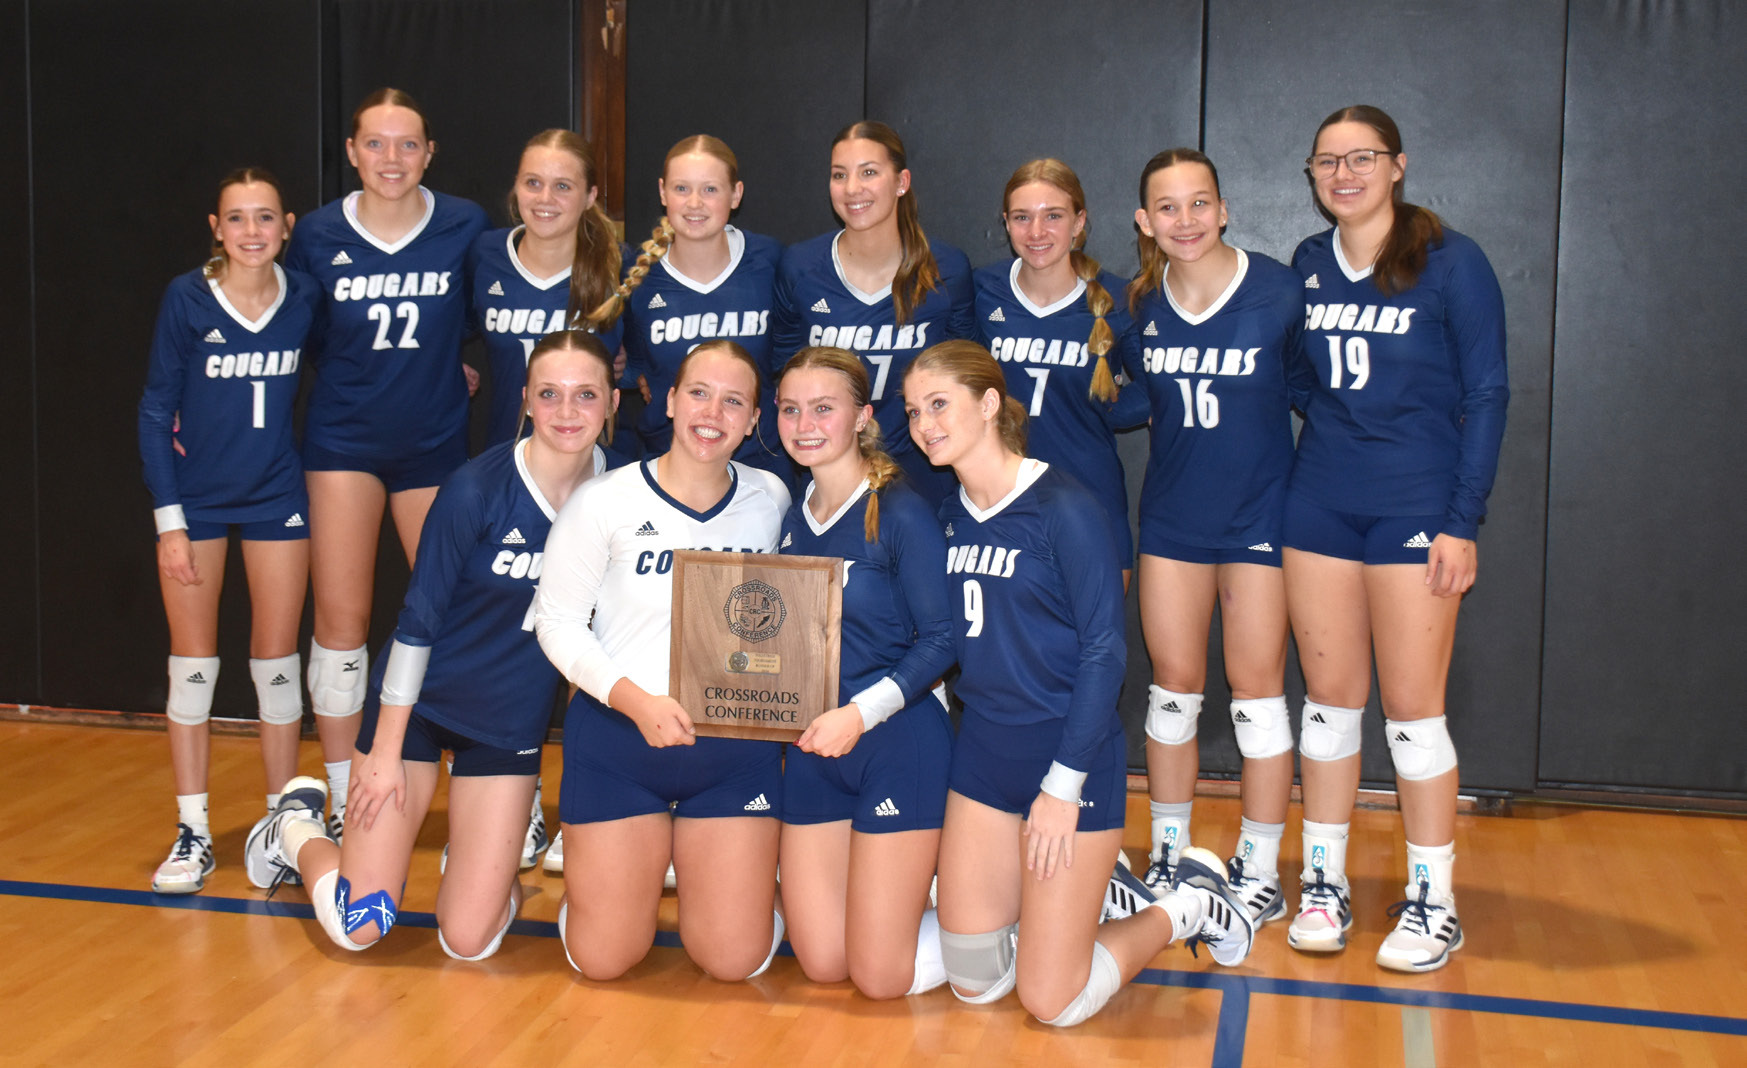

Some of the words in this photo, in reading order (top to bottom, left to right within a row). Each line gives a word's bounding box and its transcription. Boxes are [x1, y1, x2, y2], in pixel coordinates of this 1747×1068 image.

[334, 272, 451, 302] COUGARS
[368, 302, 420, 350] 22
[486, 308, 595, 334] COUGA
[651, 310, 769, 345] COUGARS
[810, 322, 931, 350] COUGARS
[991, 336, 1089, 367] COUGARS
[1143, 347, 1262, 376] COUGARS
[1325, 335, 1370, 390] 19
[250, 381, 265, 429] 1
[1024, 368, 1050, 417] 7
[1174, 378, 1220, 429] 16
[947, 545, 1021, 578] OUGARS
[963, 579, 984, 638] 9
[704, 687, 799, 705] CROSSROADS
[705, 705, 797, 723] CONFERENCE
